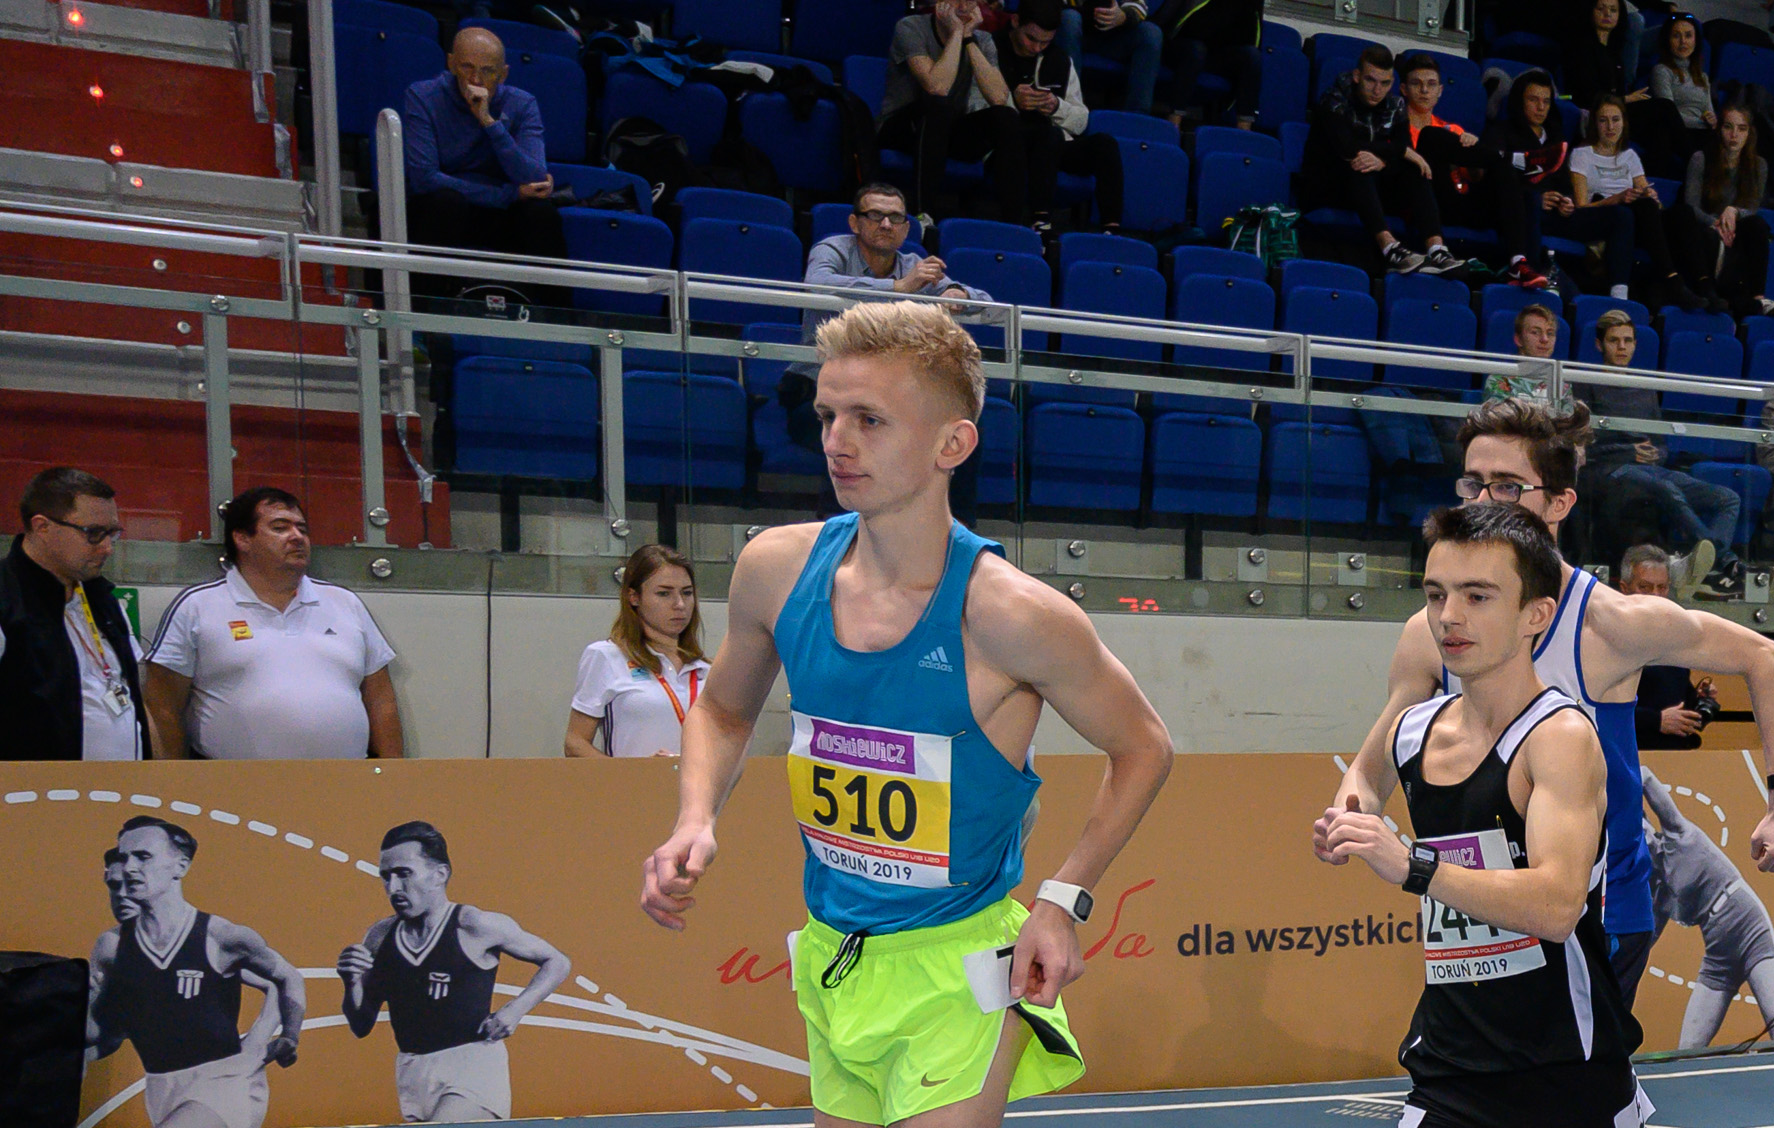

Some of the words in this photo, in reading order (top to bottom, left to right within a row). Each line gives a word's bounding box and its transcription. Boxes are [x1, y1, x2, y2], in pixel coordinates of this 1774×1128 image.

[918, 659, 954, 673] adidas
[816, 730, 907, 765] noskiewicz
[812, 764, 918, 842] 510
[823, 846, 868, 874] TORUŃ
[873, 861, 912, 880] 2019
[1177, 924, 1235, 957] dla
[1432, 959, 1471, 979] TORUŃ
[1474, 958, 1508, 976] 2019
